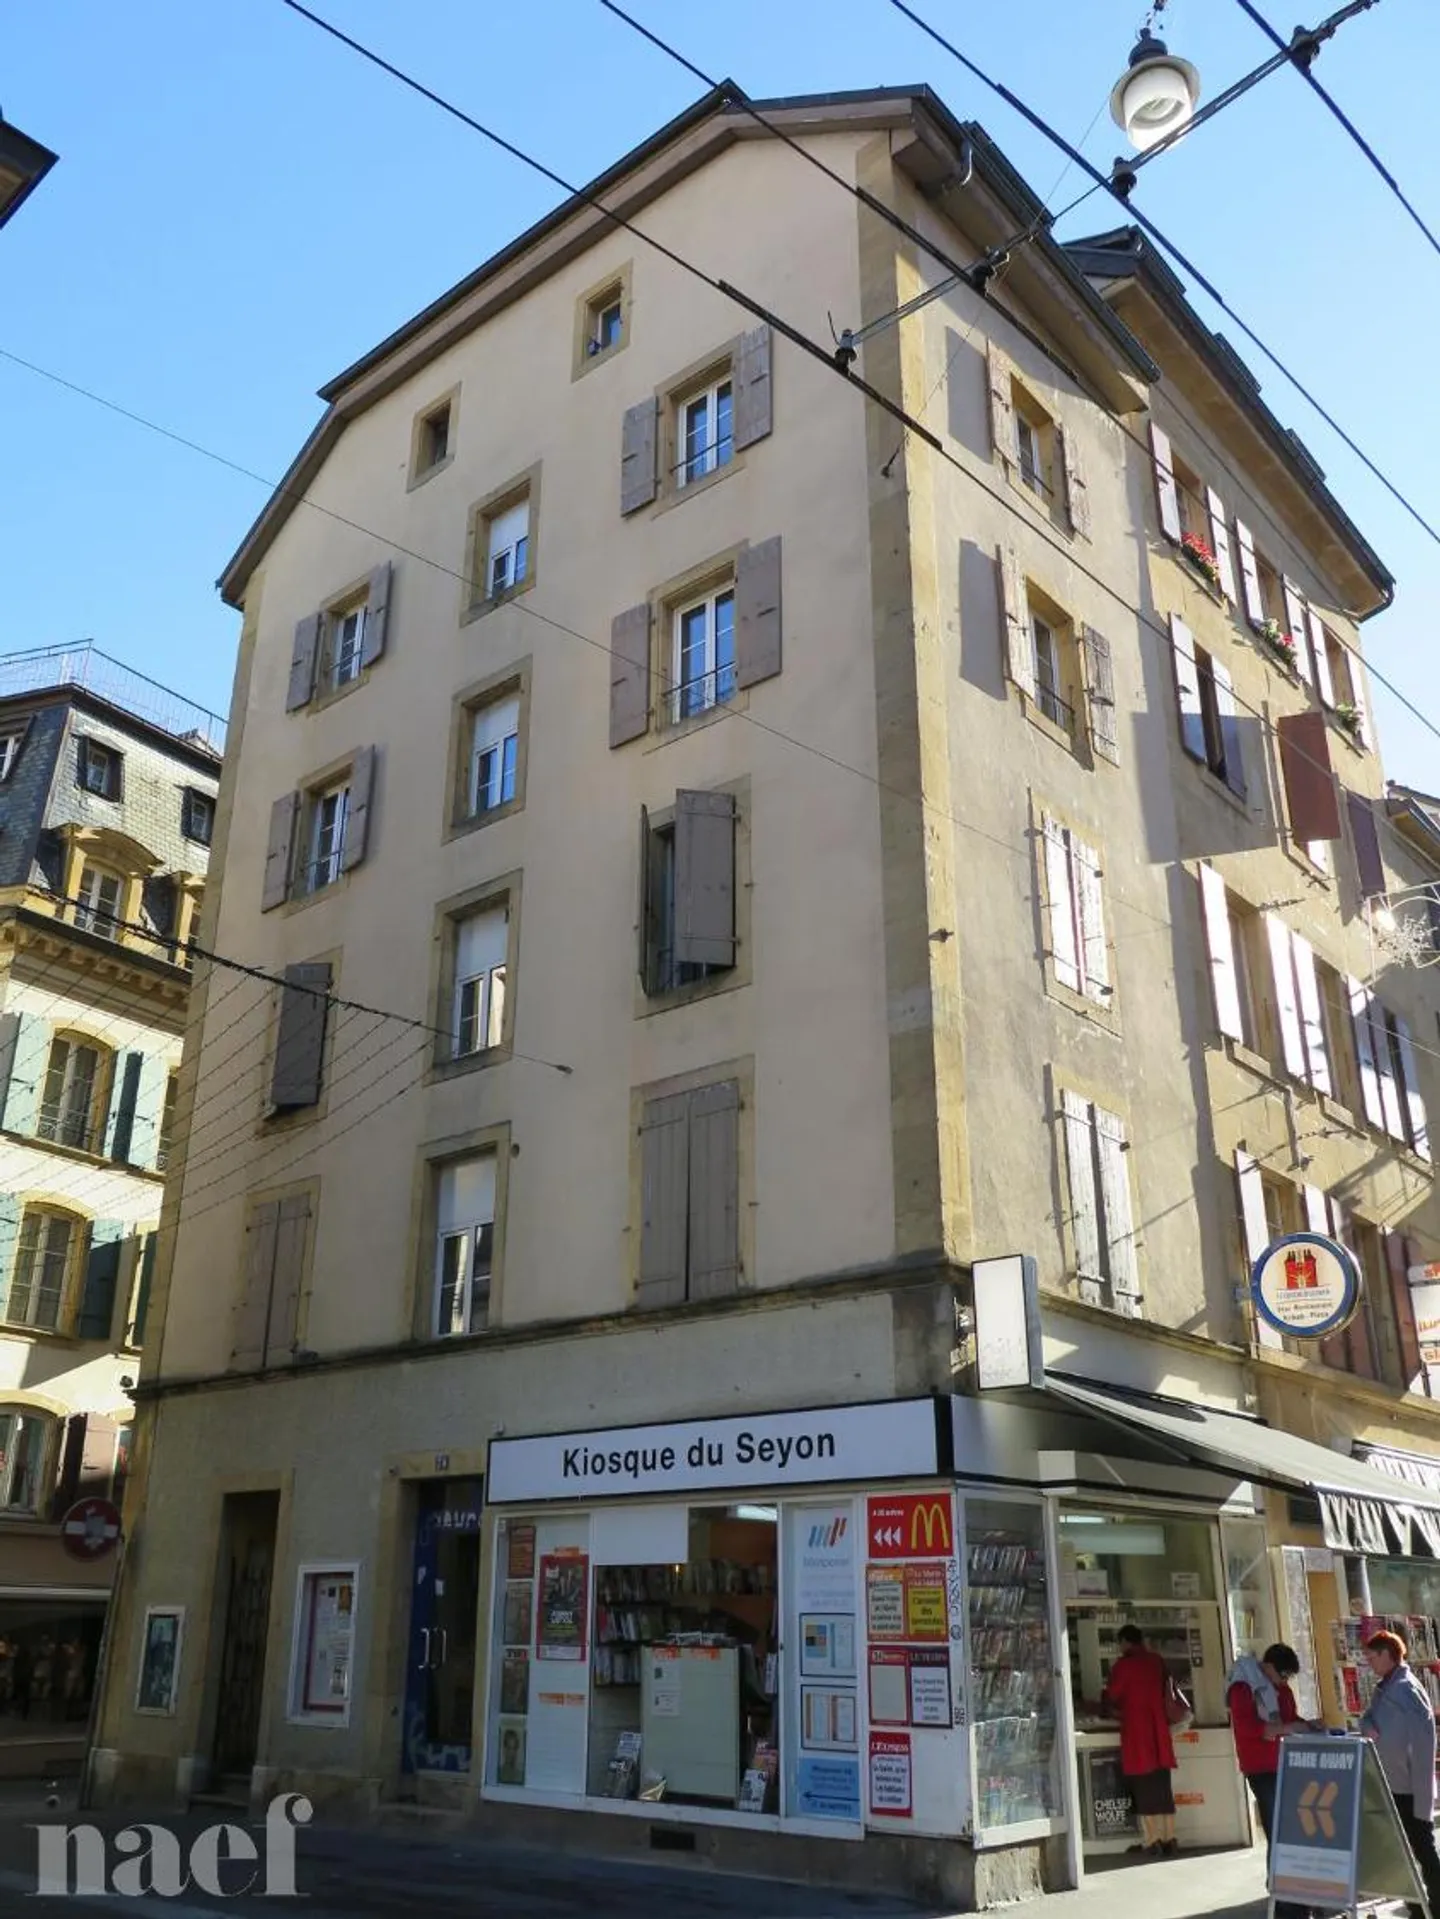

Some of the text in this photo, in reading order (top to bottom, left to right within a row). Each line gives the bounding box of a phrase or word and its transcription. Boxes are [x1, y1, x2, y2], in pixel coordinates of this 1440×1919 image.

[562, 1432, 835, 1479] Kiosque du Seyon
[1287, 1751, 1355, 1770] TAKE AWAY
